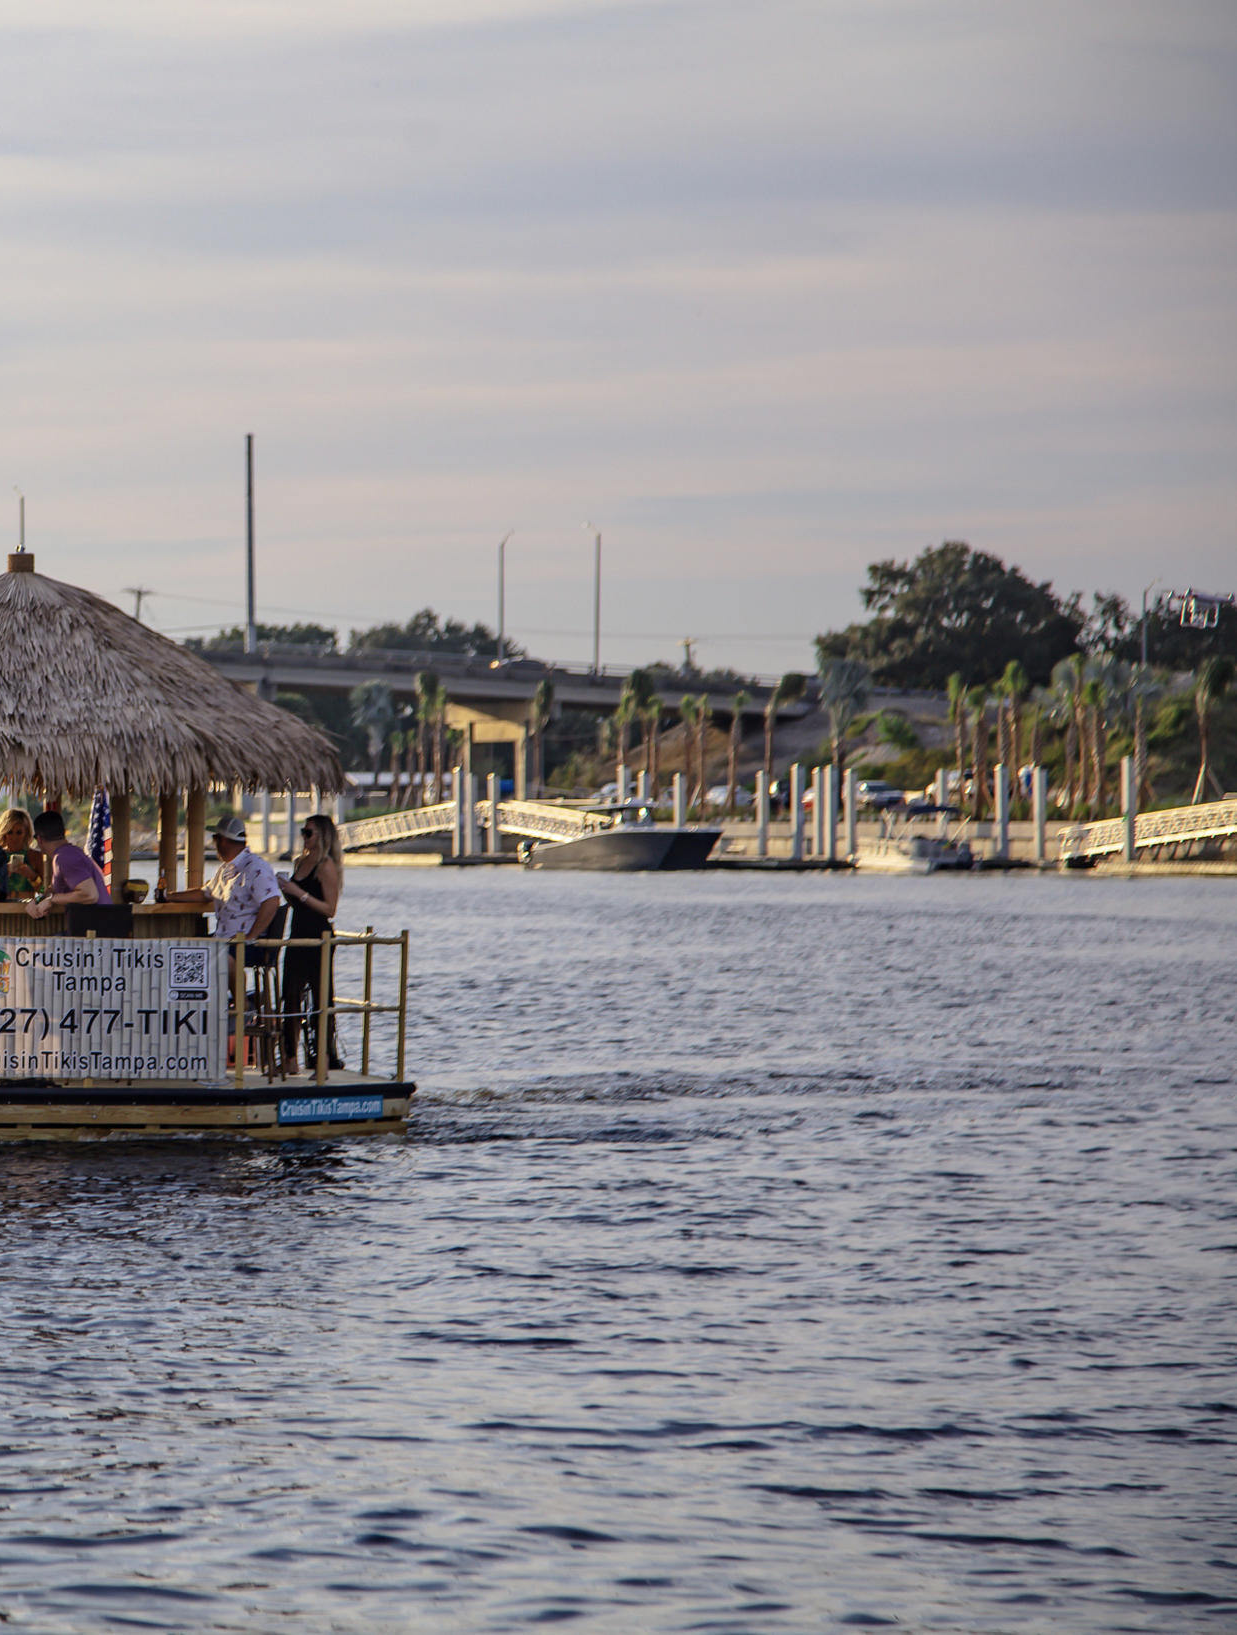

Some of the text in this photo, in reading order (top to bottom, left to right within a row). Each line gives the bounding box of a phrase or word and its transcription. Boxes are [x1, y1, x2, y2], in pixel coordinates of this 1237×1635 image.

[113, 948, 165, 969] Tikis
[52, 971, 127, 997] Tampa
[59, 1008, 209, 1035] 477-TIKI
[280, 1098, 381, 1117] CruisinTikisTampa.com
